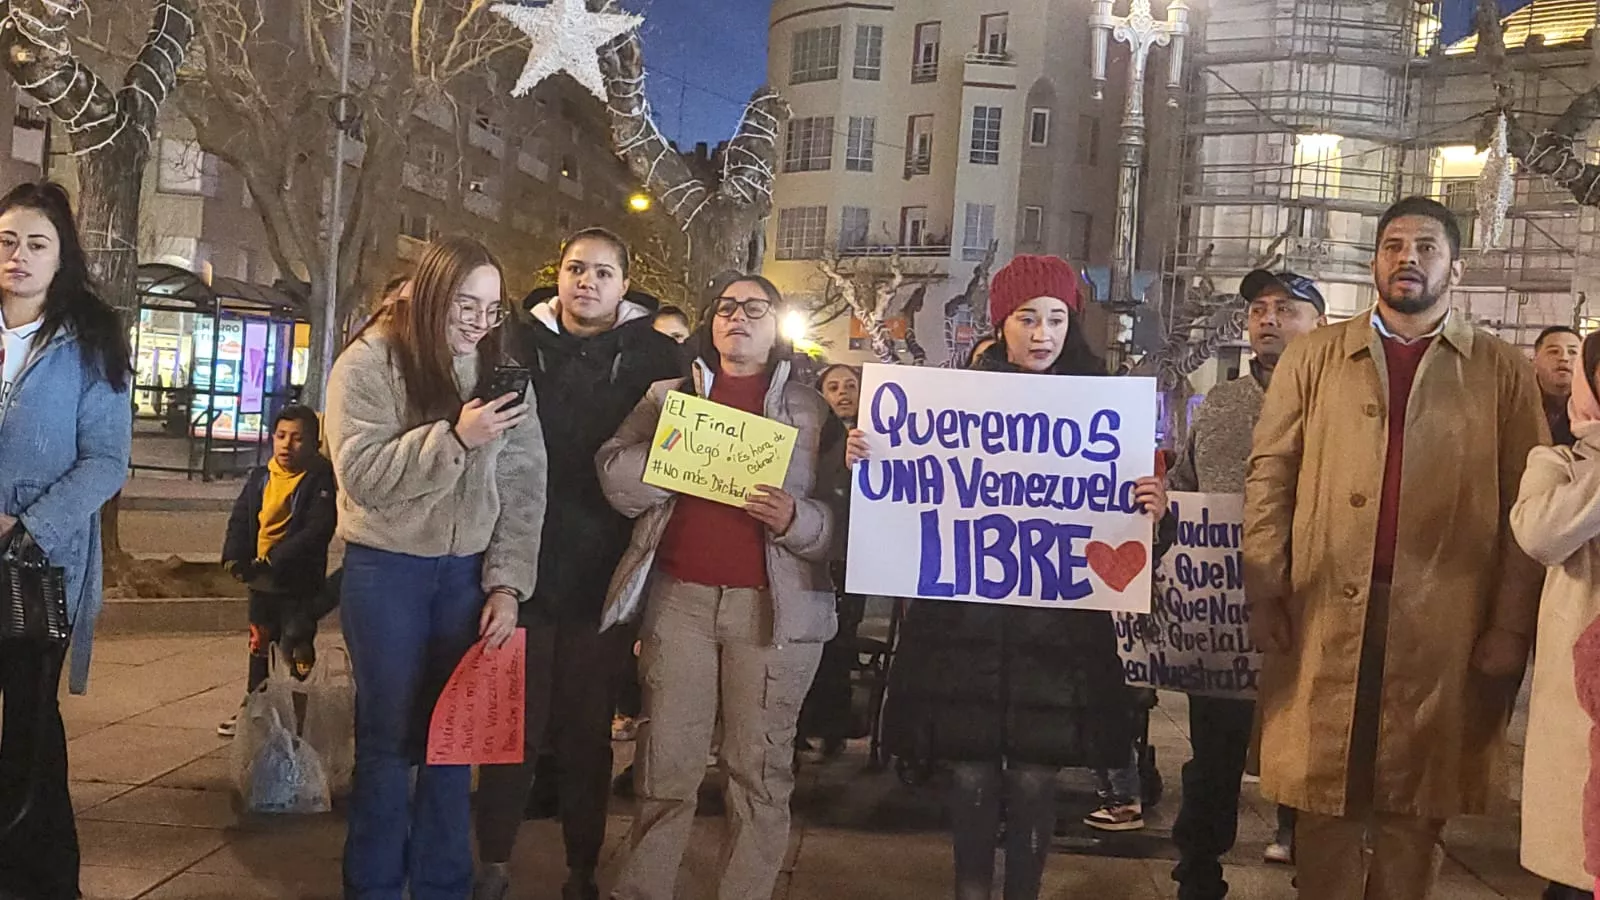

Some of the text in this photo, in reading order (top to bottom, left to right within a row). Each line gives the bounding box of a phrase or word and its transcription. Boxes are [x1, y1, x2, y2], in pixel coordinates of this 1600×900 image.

[695, 413, 746, 442] Final
[750, 441, 774, 461] hora
[773, 431, 786, 443] de
[683, 469, 708, 486] más
[858, 455, 1150, 514] UNA Venezuela
[917, 509, 1093, 601] LIBRE
